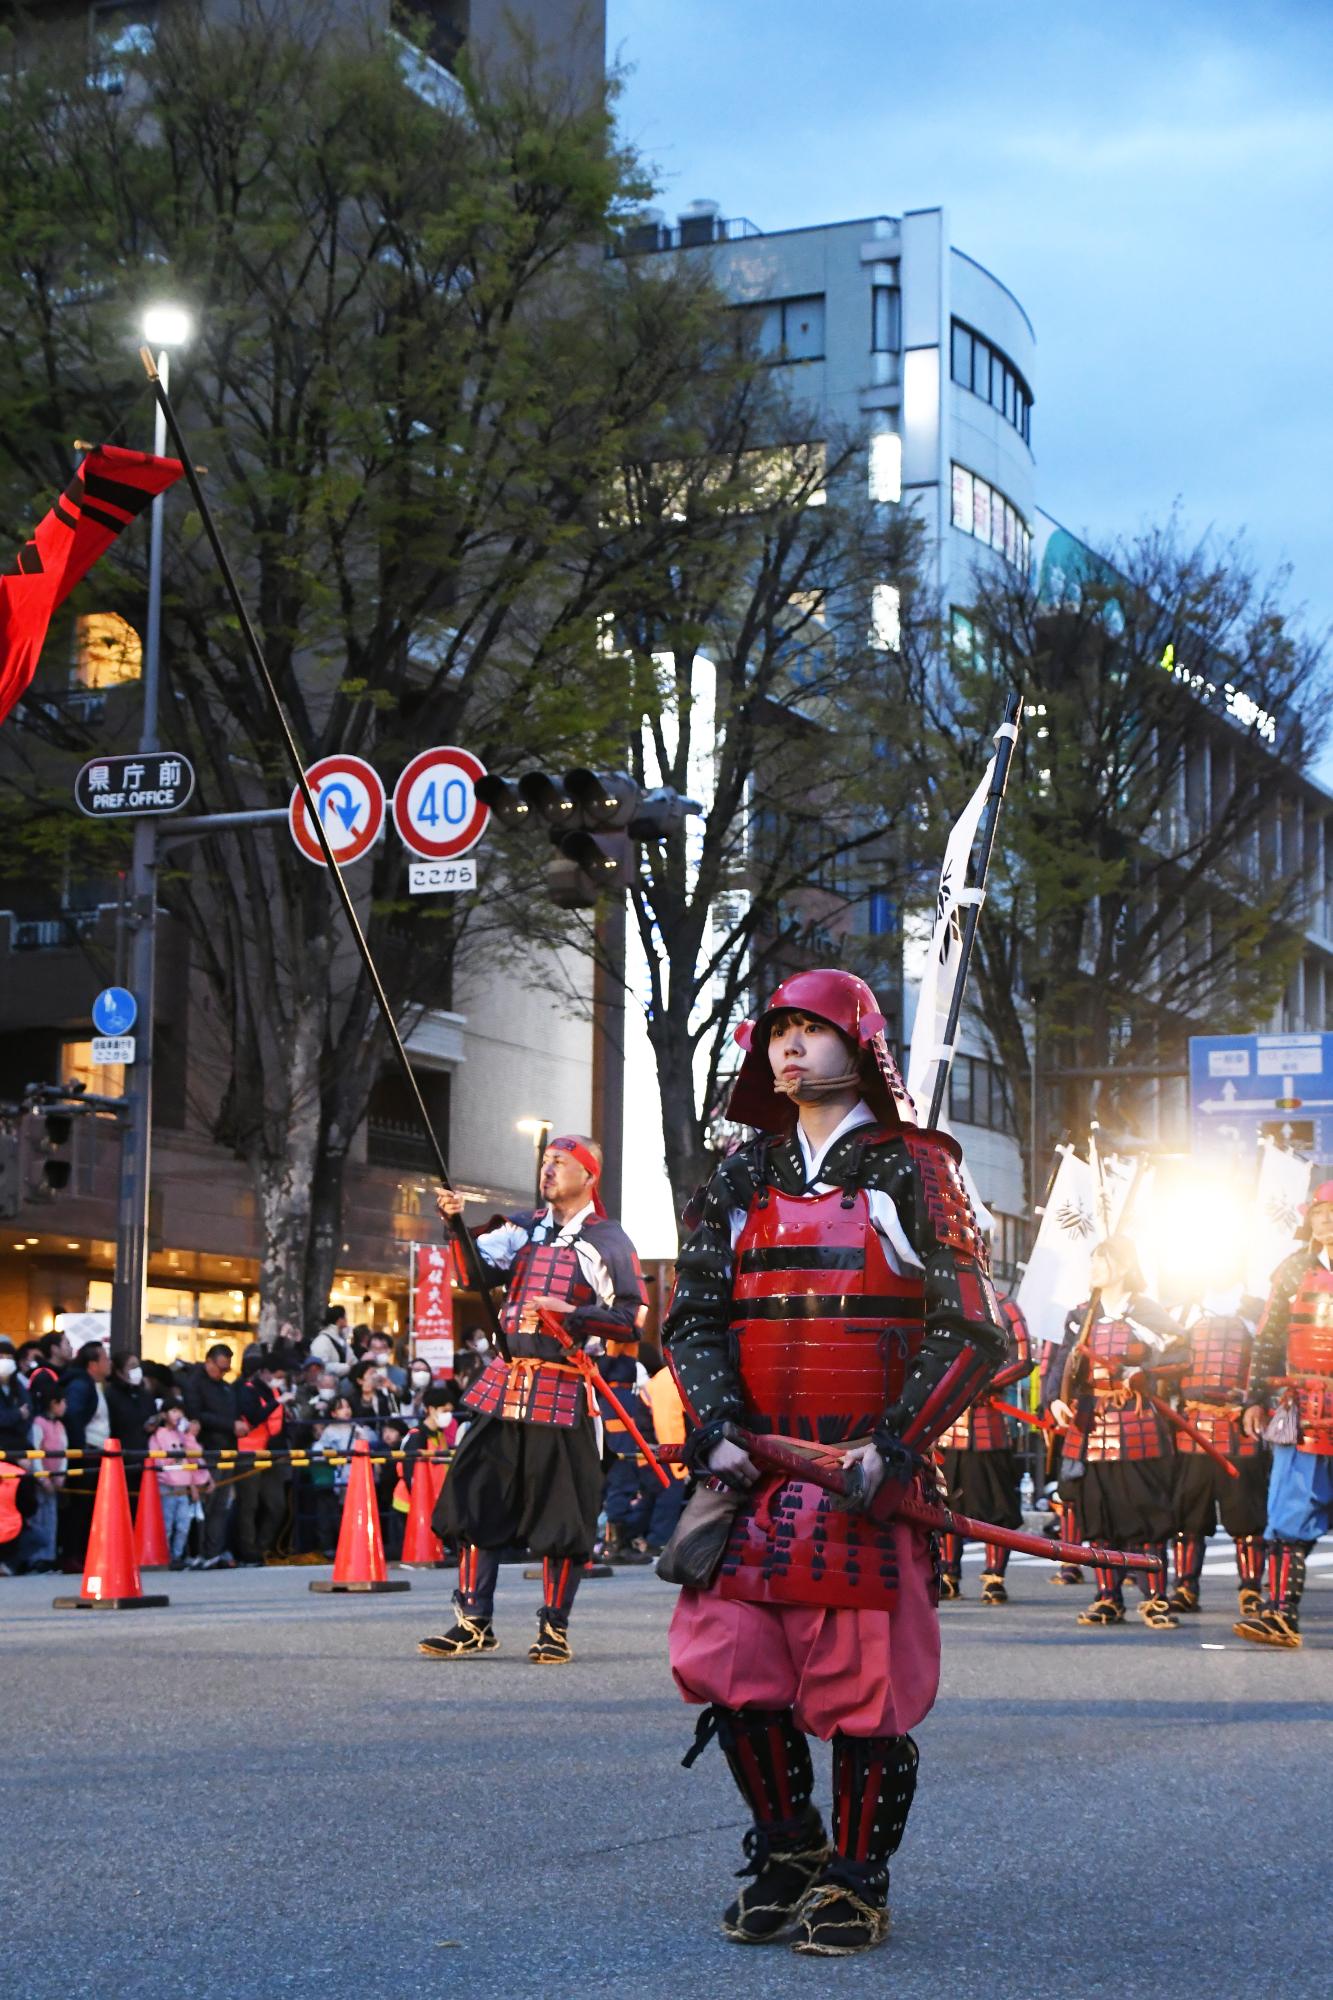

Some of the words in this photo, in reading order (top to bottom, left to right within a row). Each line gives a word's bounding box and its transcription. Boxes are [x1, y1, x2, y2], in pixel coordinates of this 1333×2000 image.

[88, 760, 181, 792] 県庁前
[417, 779, 467, 827] 40
[413, 866, 472, 886] ここから
